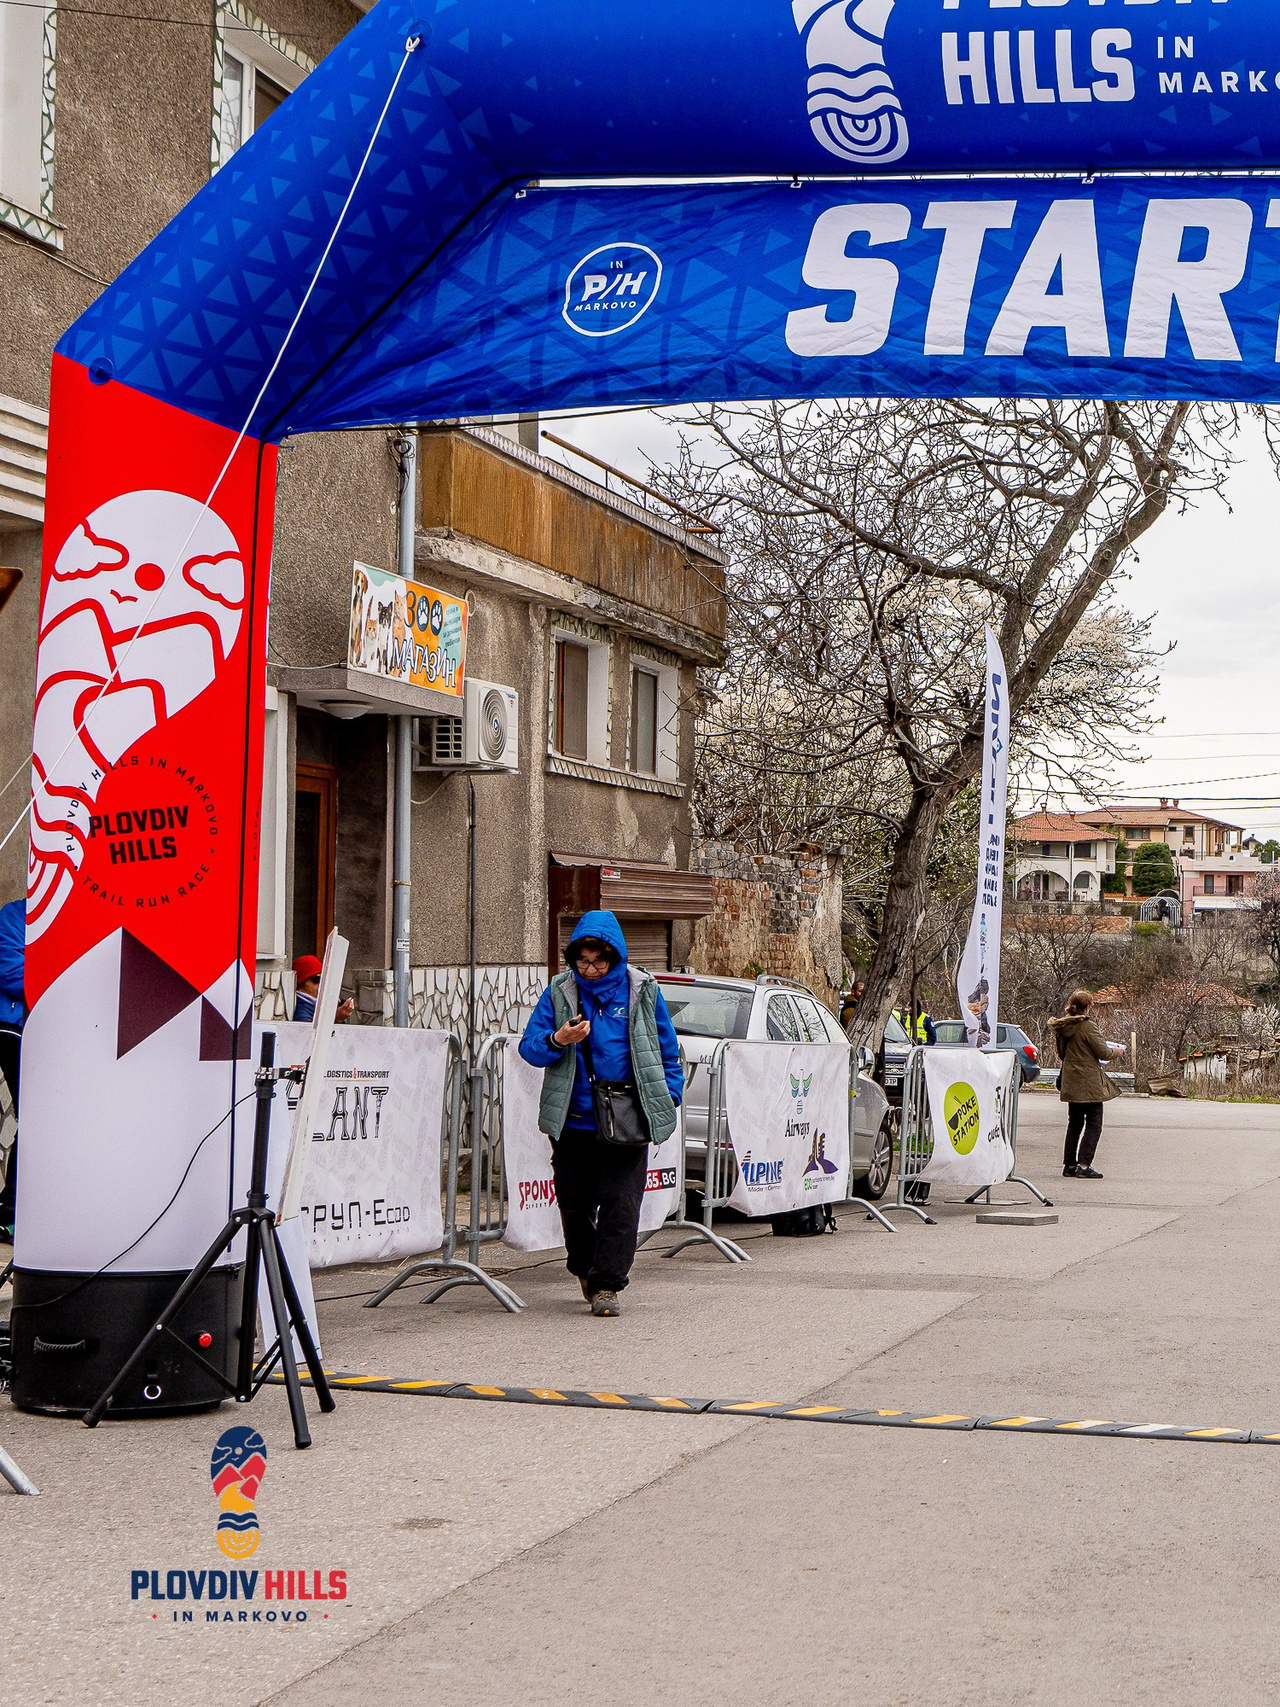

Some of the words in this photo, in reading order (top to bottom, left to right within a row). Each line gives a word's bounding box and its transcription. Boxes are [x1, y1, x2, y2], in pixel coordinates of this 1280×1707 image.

[941, 28, 1135, 105] HILLS
[1157, 36, 1194, 58] IN
[610, 260, 623, 269] IN
[581, 271, 647, 302] P/H
[574, 301, 637, 312] MARKOVO
[391, 637, 456, 688] МАГАЗИН
[149, 756, 168, 770] IN
[174, 765, 219, 836] MARKOVO
[88, 805, 189, 839] PLOVDIV
[109, 836, 178, 865] HILLS
[82, 875, 125, 907] TRAIL
[136, 894, 170, 908] RUN
[177, 863, 210, 898] RACE
[357, 1070, 390, 1079] TRANSPORT
[312, 1086, 389, 1142] ANT
[957, 1096, 977, 1120] POKE
[953, 1110, 979, 1146] STATION
[645, 1171, 676, 1189] 65.BG
